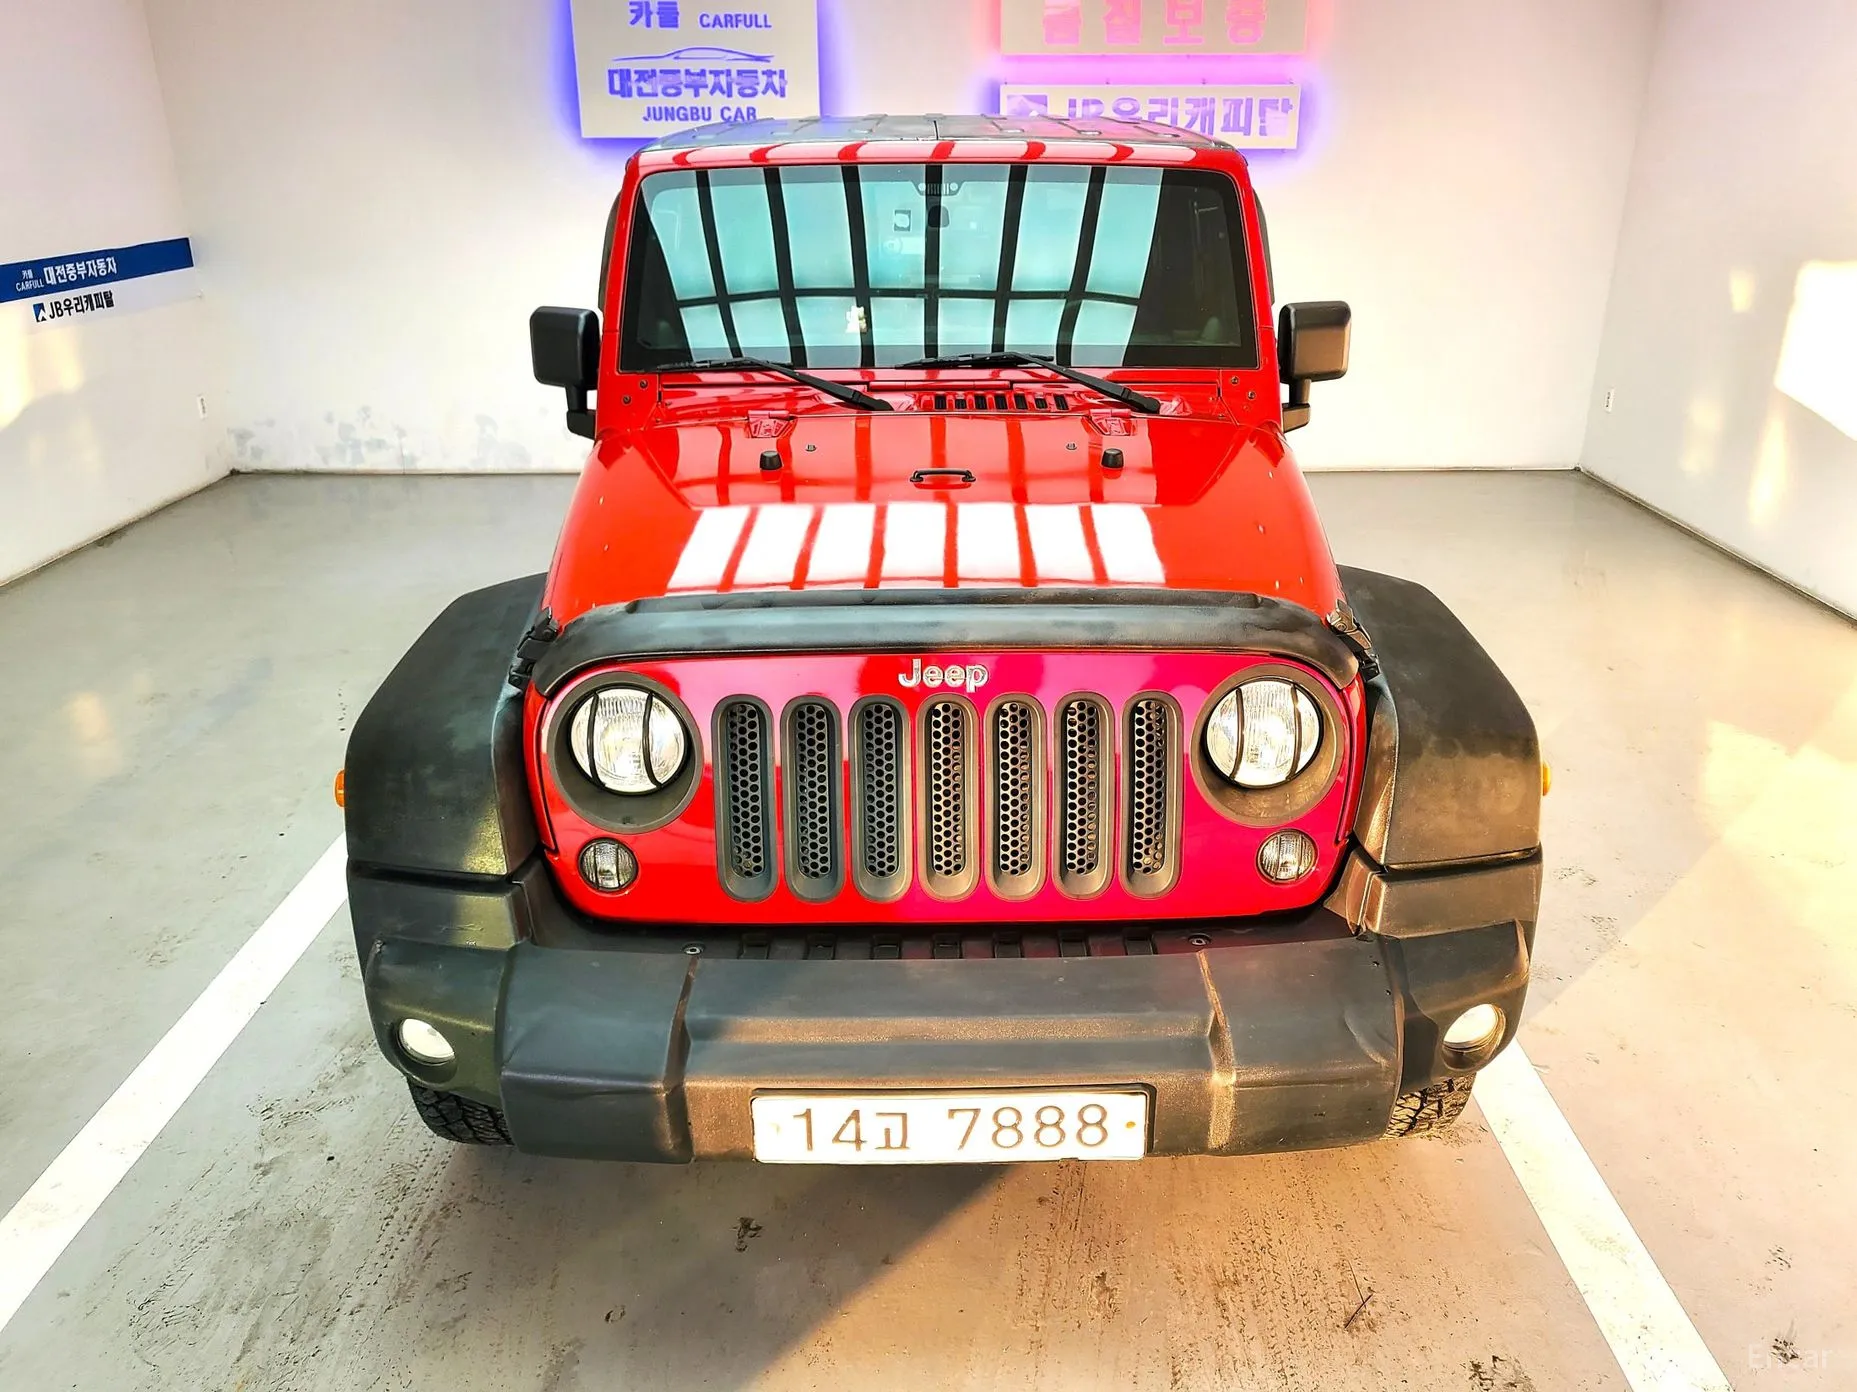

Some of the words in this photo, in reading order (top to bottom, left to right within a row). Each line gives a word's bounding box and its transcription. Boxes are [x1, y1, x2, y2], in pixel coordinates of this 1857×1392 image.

[699, 13, 773, 29] CARFULL
[607, 68, 788, 99] 대전중부자동차
[643, 105, 713, 123] JUNGBU
[720, 106, 757, 123] CAR
[15, 278, 45, 292] CARFULL
[43, 256, 117, 285] 대전중부자동차
[49, 290, 115, 319] JB우리캐피탈
[897, 658, 989, 693] Jeep
[792, 1107, 911, 1152] 14고
[947, 1103, 1109, 1152] 7888
